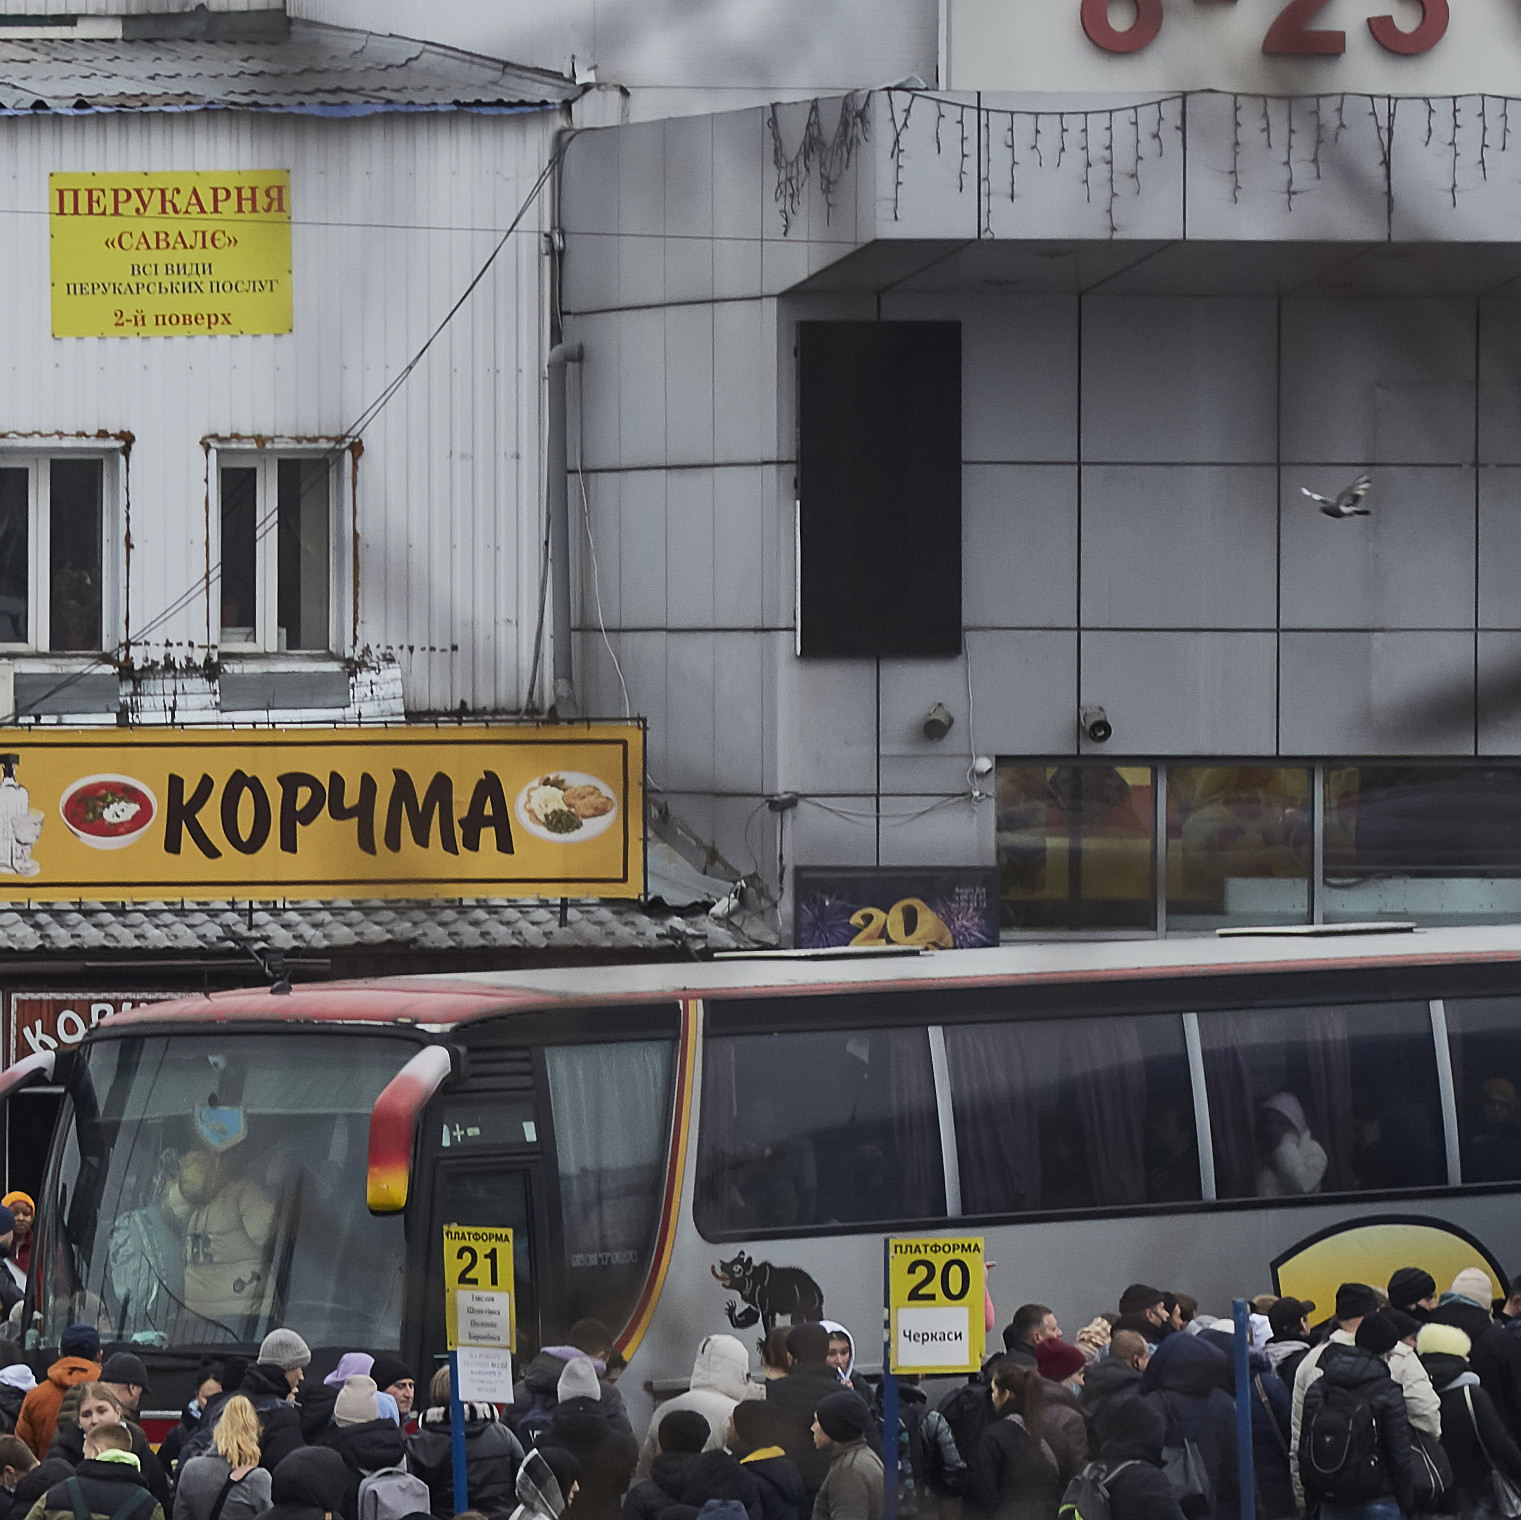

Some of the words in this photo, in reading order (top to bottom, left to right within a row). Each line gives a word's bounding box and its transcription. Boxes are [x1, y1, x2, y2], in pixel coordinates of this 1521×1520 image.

[55, 185, 287, 216] ПЕРУКАРНЯ
[104, 230, 238, 251] «САВАЛЄ»
[130, 263, 158, 277] ВСІ
[164, 262, 213, 278] ВИДИ
[66, 281, 205, 296] ПЕРУКАРСЬКИХ
[209, 279, 280, 294] ПОСЛУГ
[114, 309, 146, 328] 2-й
[154, 312, 233, 330] поверх
[162, 768, 516, 861] КОРЧМА
[446, 1230, 511, 1244] ПЛАТФОРМА
[894, 1243, 981, 1255] ПЛАТФОРМА
[456, 1245, 498, 1287] 21
[907, 1259, 971, 1301] 20
[902, 1329, 963, 1345] Черкаси
